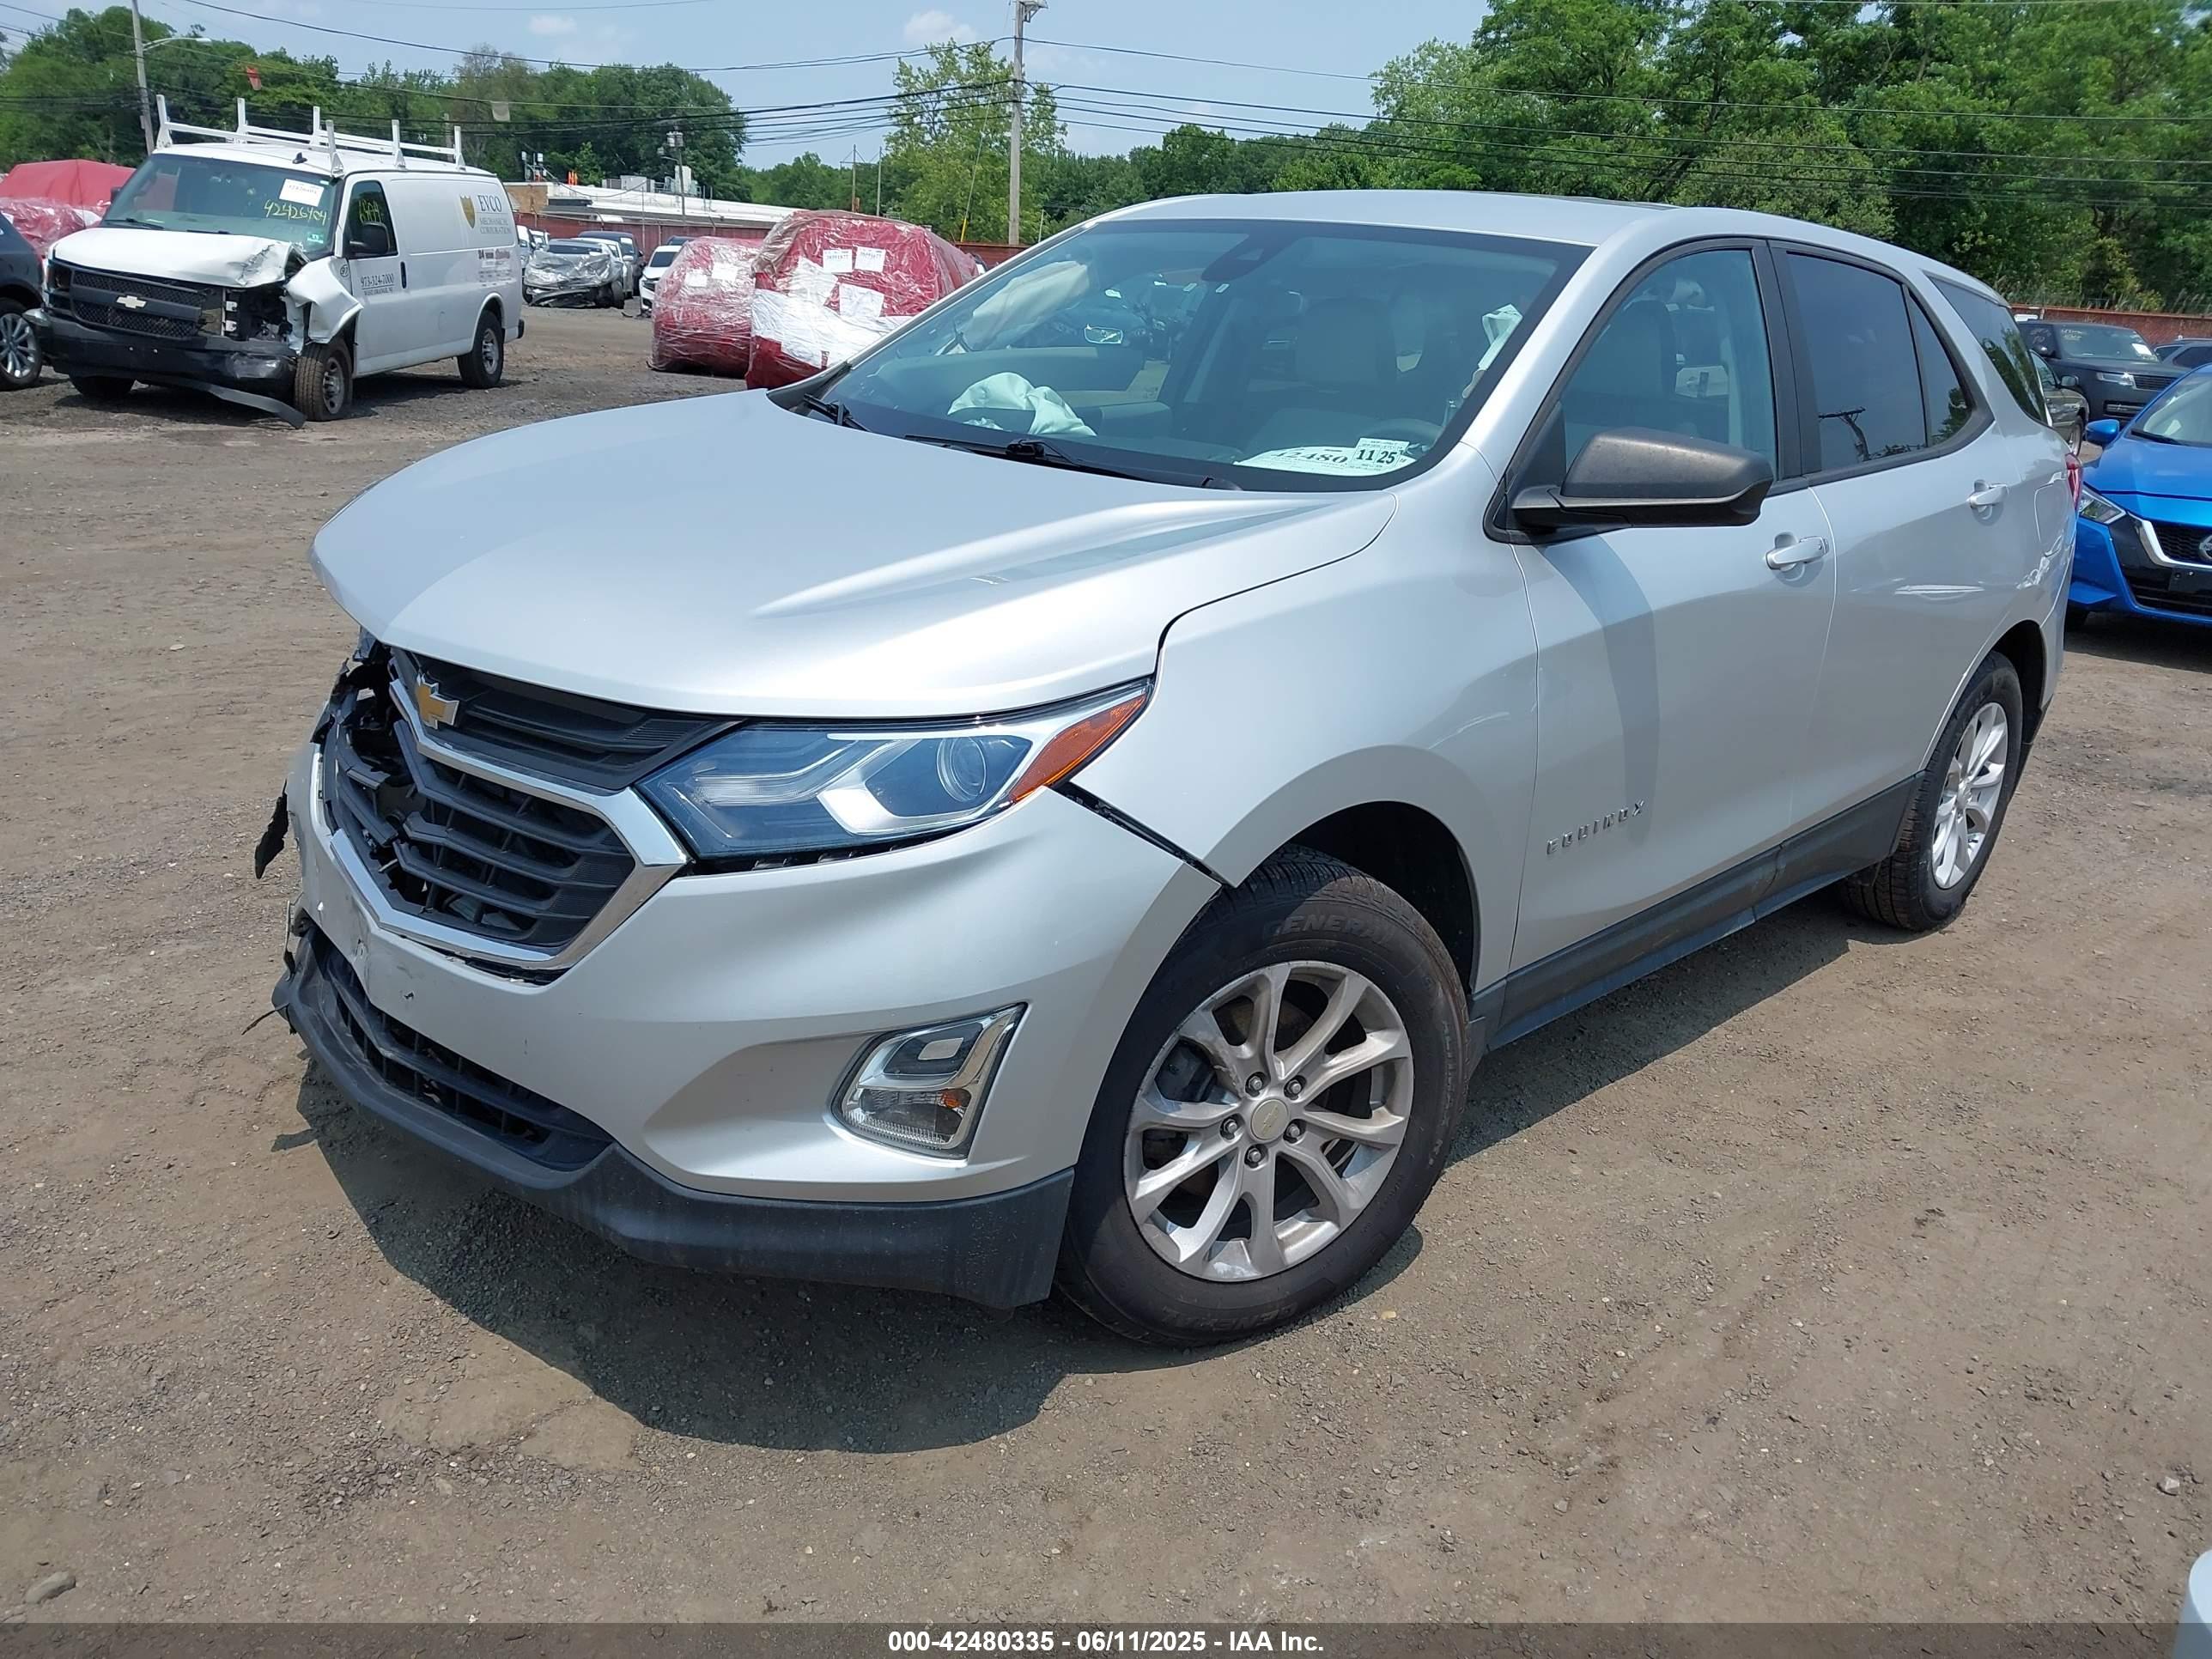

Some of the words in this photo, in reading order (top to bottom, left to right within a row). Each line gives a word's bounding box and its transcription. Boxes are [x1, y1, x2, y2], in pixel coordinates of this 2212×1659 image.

[477, 194, 502, 212] EVCO
[1356, 449, 1375, 461] 11
[1376, 451, 1398, 464] 25
[1546, 799, 1645, 855] EQUINOX
